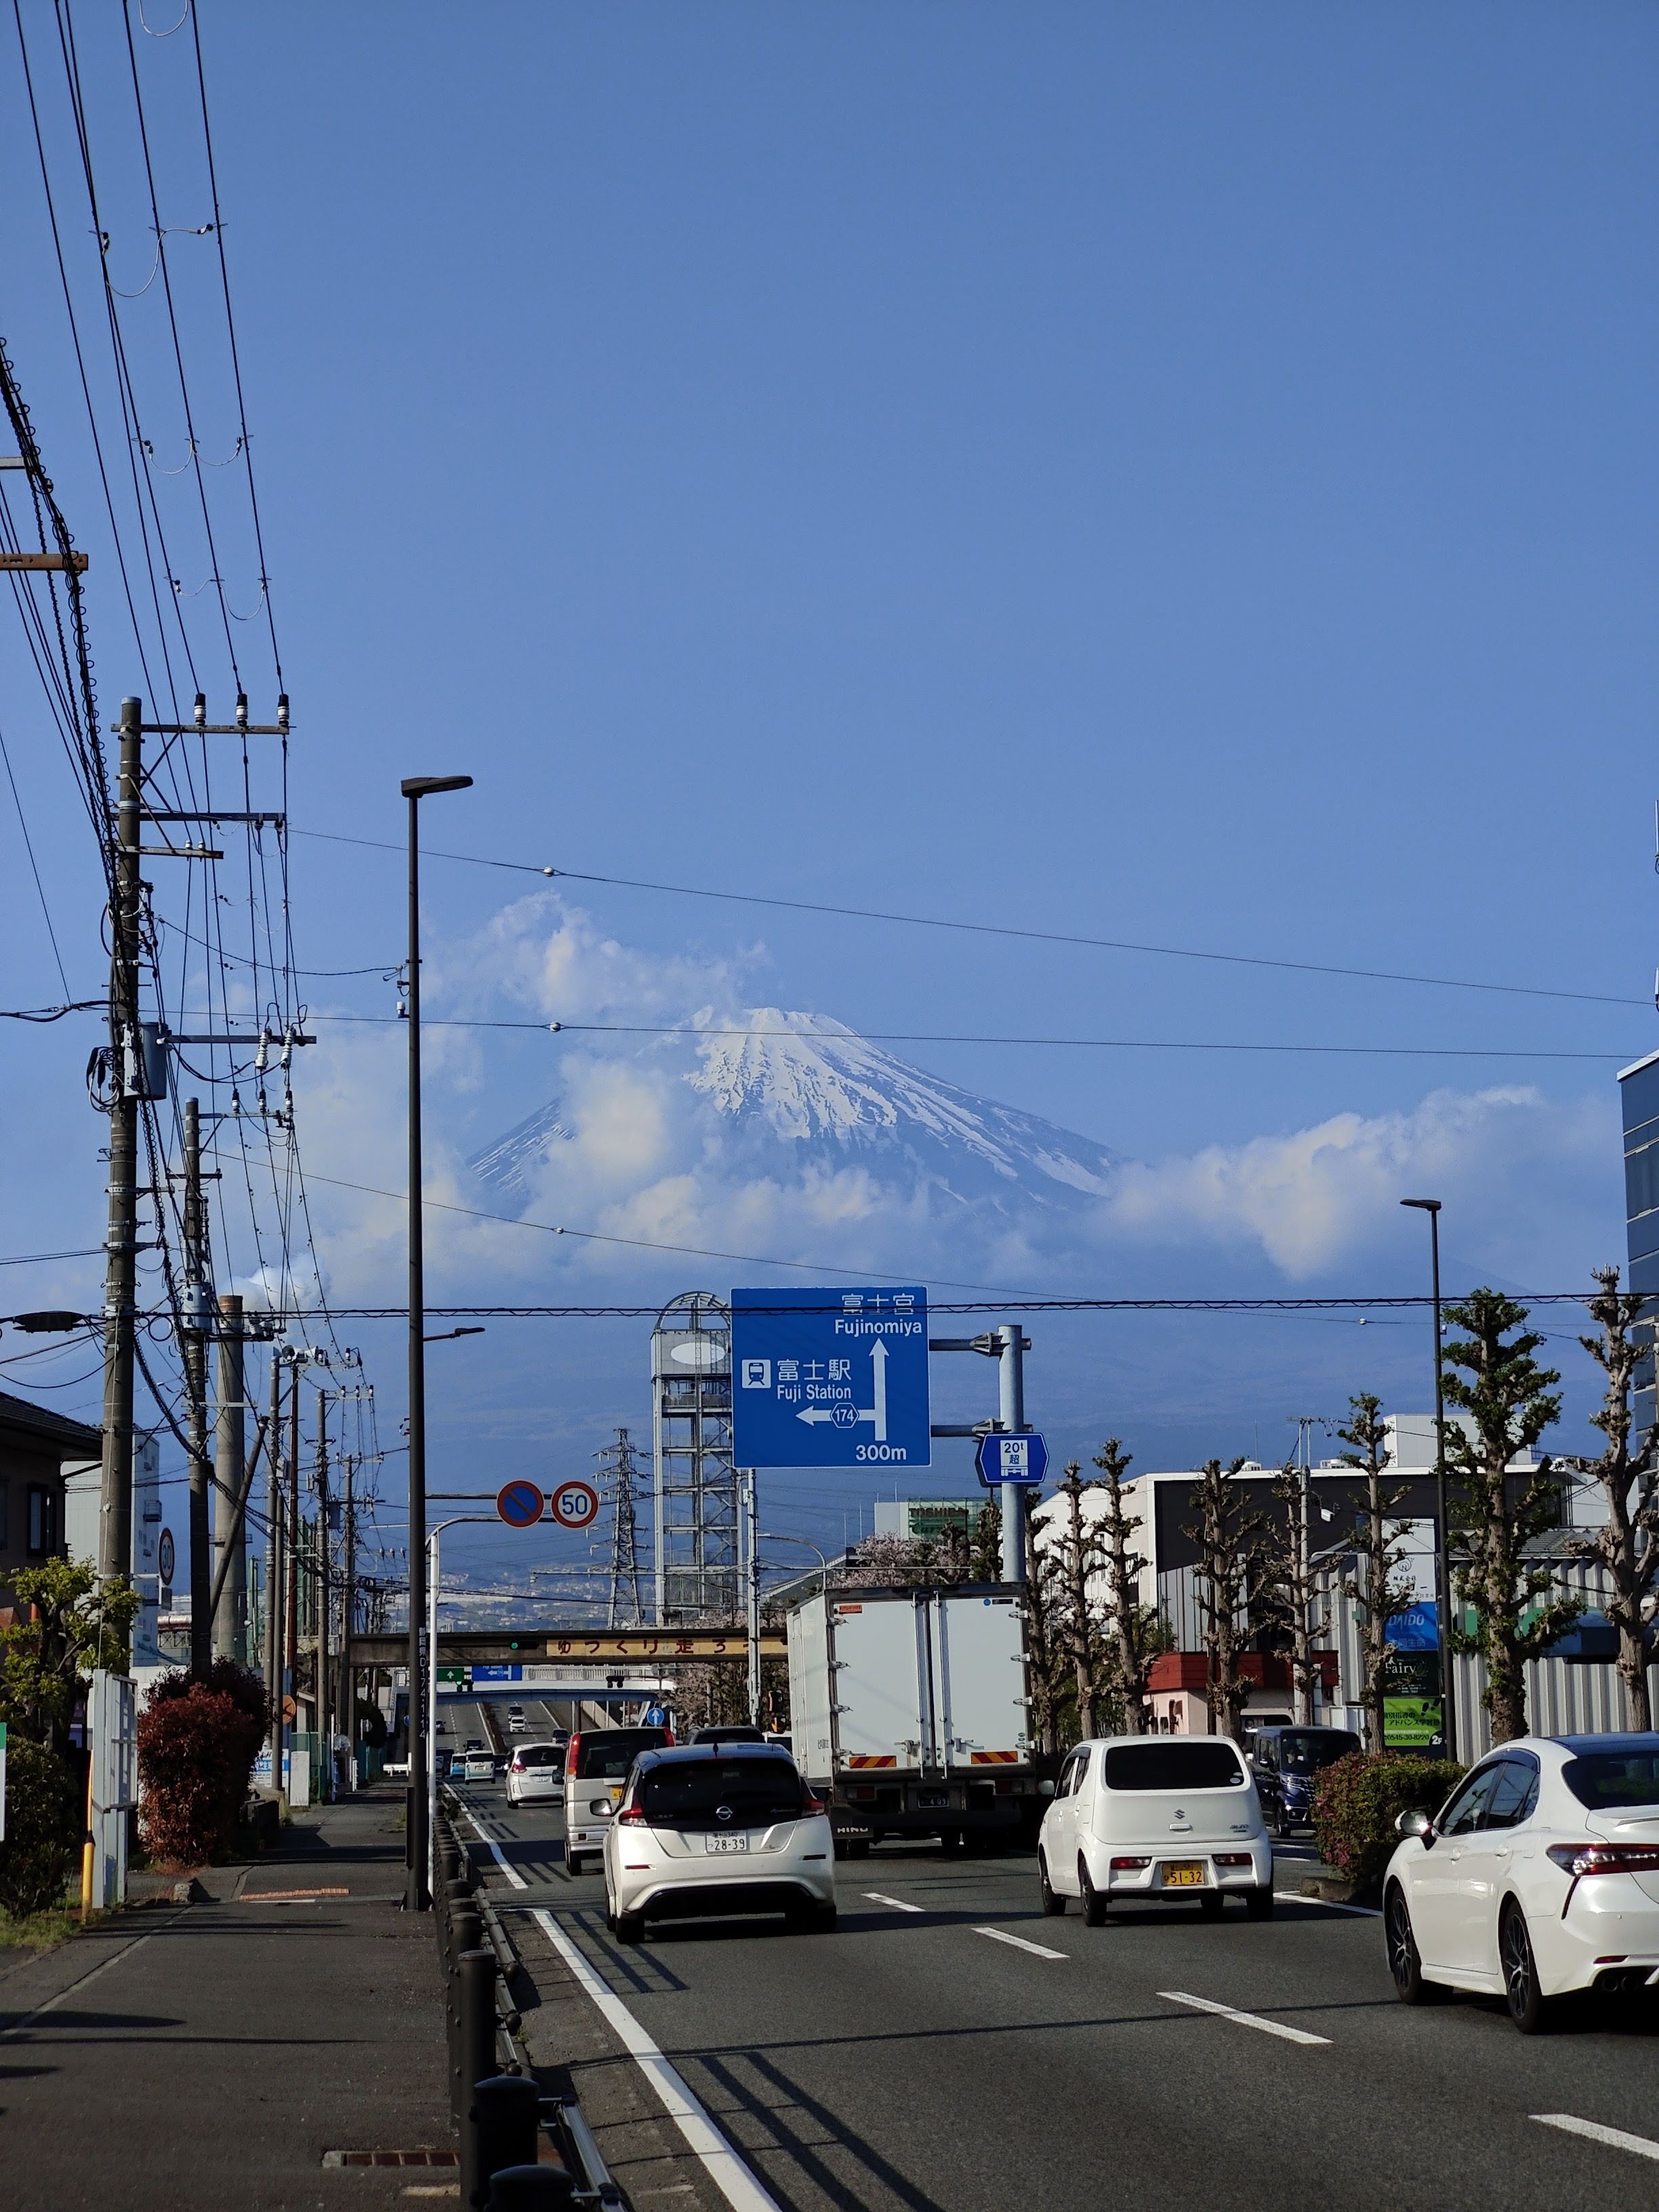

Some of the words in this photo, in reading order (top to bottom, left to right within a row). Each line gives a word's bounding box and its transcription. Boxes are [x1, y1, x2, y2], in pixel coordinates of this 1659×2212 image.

[842, 1293, 915, 1315] 富士宮
[835, 1318, 922, 1338] Fujinomiya
[777, 1359, 852, 1380] 富士駅
[777, 1385, 801, 1403] Fuji
[806, 1384, 852, 1400] Station
[835, 1409, 855, 1422] 174
[856, 1445, 907, 1460] 300m
[1004, 1442, 1024, 1453] 20t
[1009, 1454, 1019, 1464] 超
[562, 1494, 588, 1515] 50
[162, 1544, 171, 1570] 30
[1388, 1614, 1425, 1629] DAIDO
[1432, 1735, 1443, 1745] 2F
[714, 1838, 745, 1851] 28-39
[1170, 1871, 1202, 1883] 51-32
